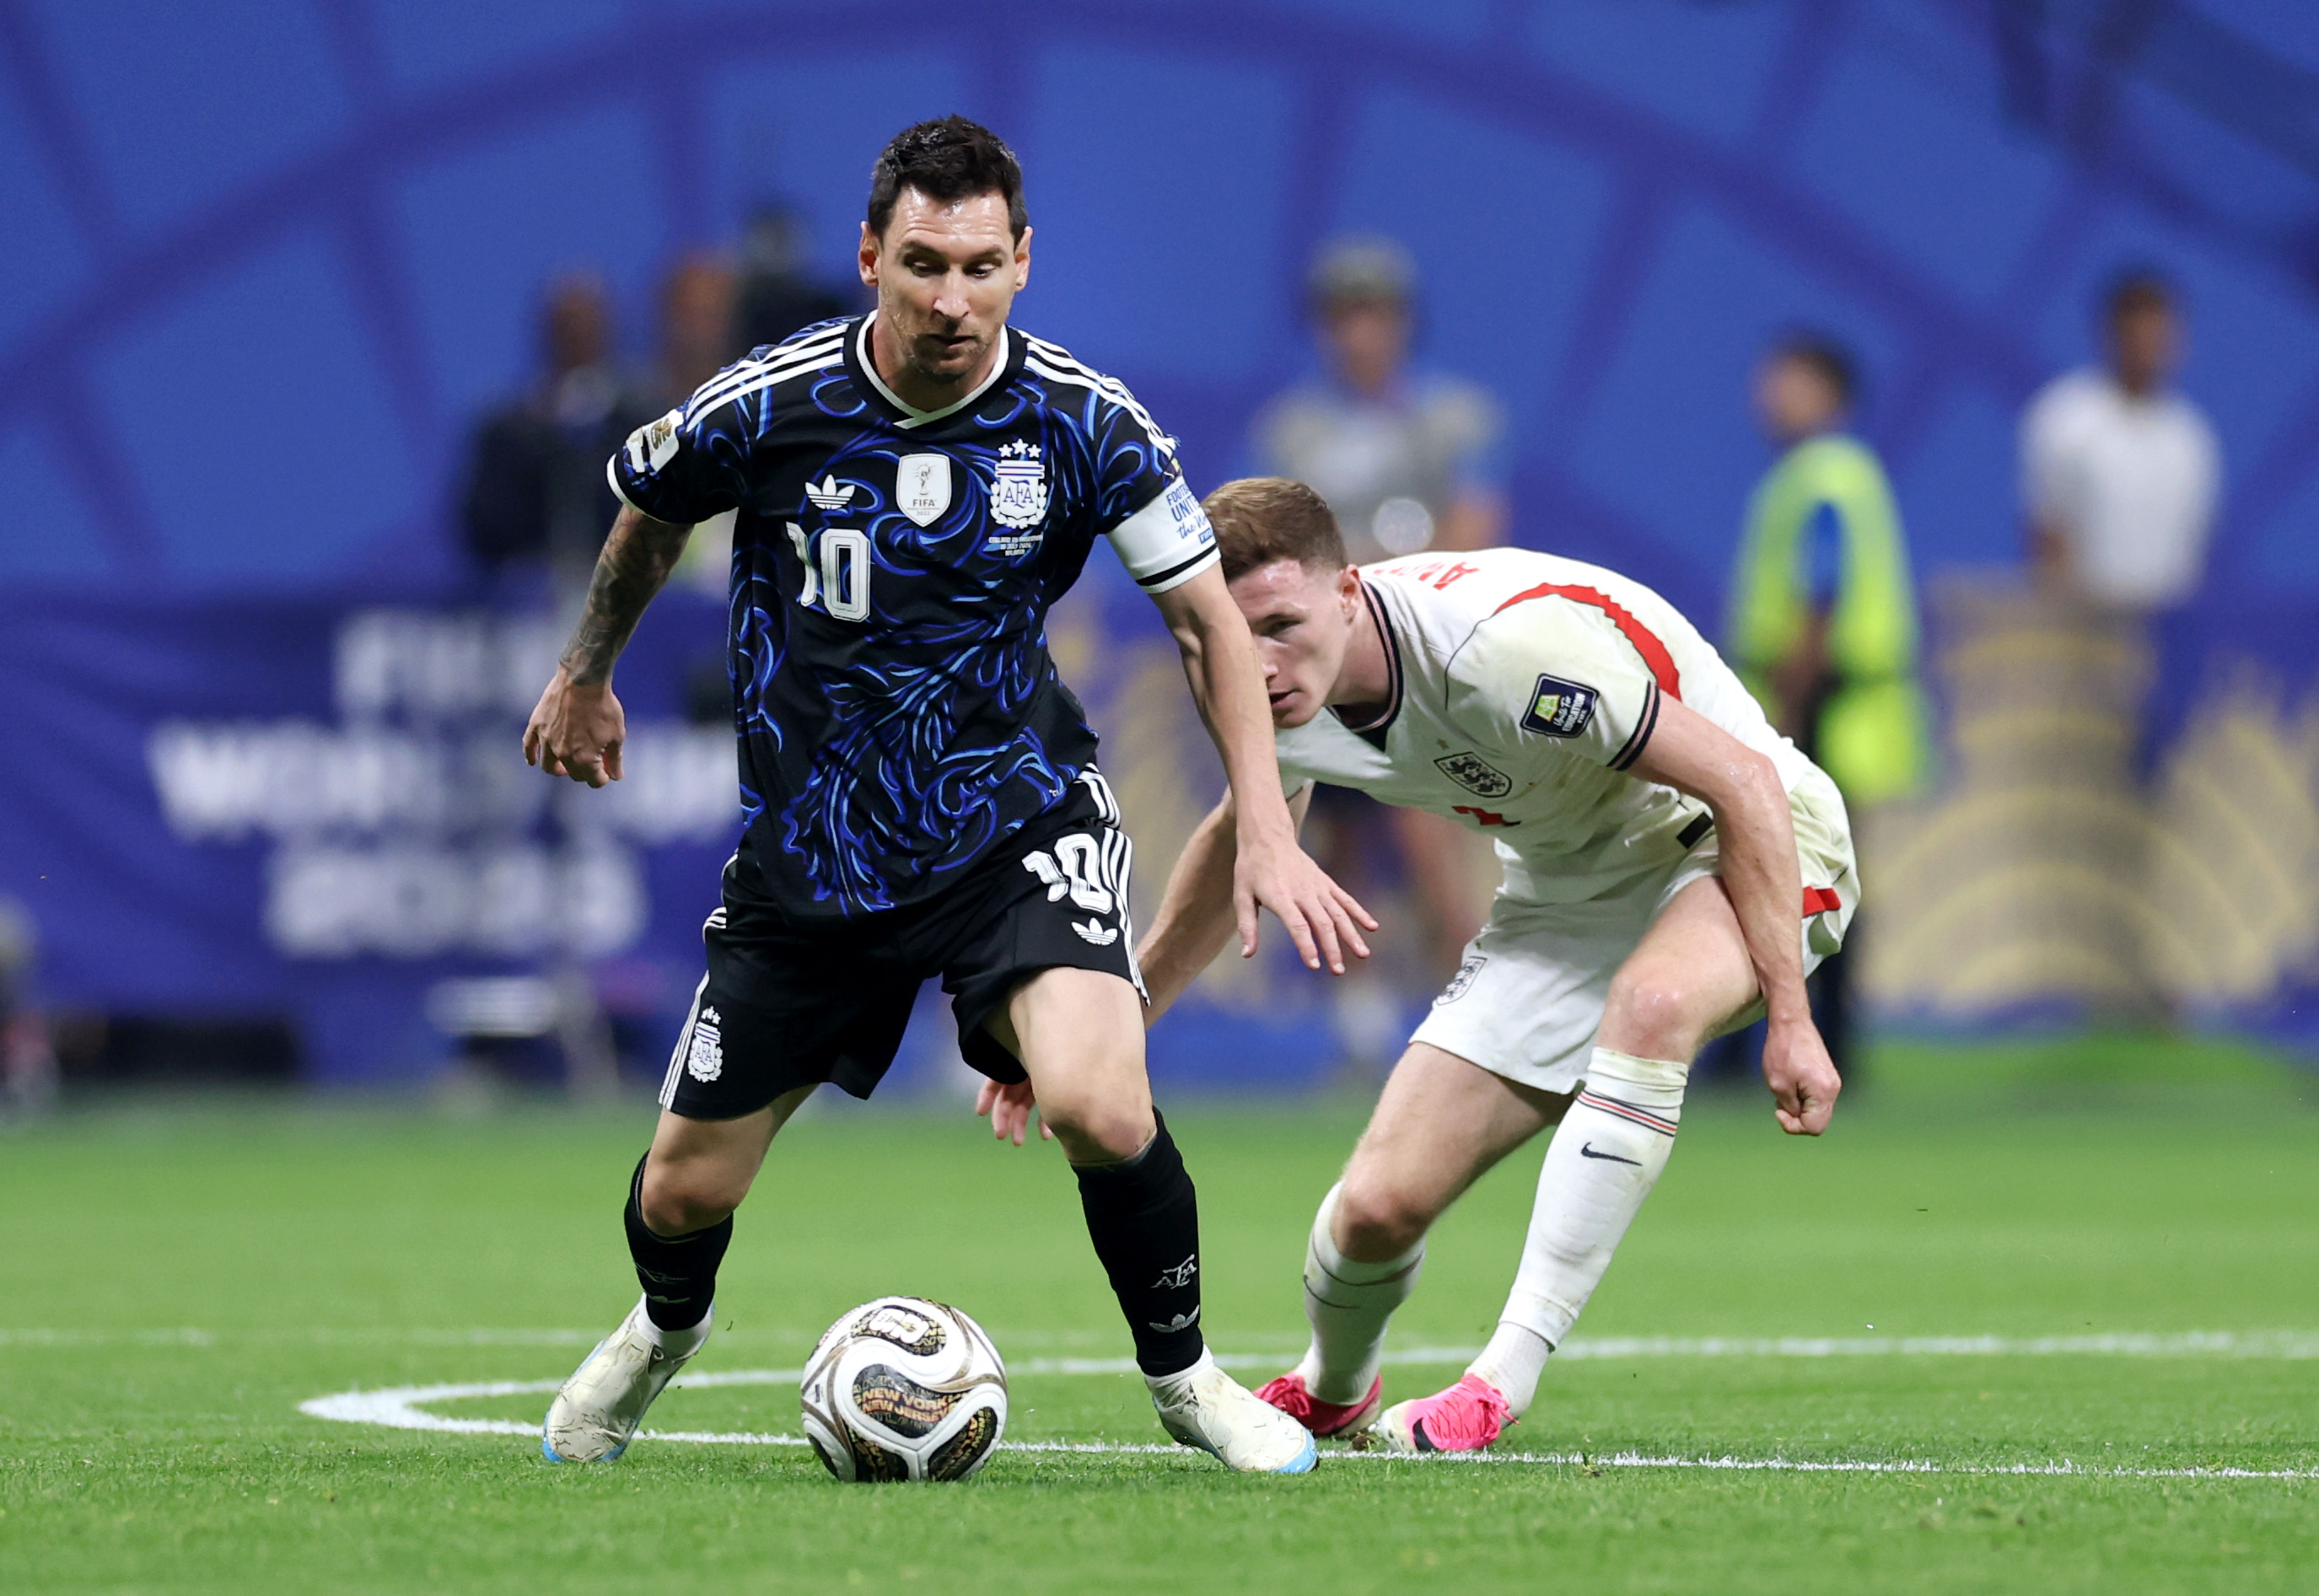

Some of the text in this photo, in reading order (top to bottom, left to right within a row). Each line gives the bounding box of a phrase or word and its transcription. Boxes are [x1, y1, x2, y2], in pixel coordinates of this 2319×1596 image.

[912, 498, 935, 507] FIFA
[1003, 479, 1034, 508] AFA
[786, 521, 871, 622] 10
[1562, 692, 1586, 732] EDUCATION
[1021, 833, 1113, 915] 10
[862, 1387, 901, 1403] NEW
[901, 1392, 949, 1411] YORK
[862, 1399, 894, 1414] NEW
[894, 1405, 948, 1422] JERSEY
